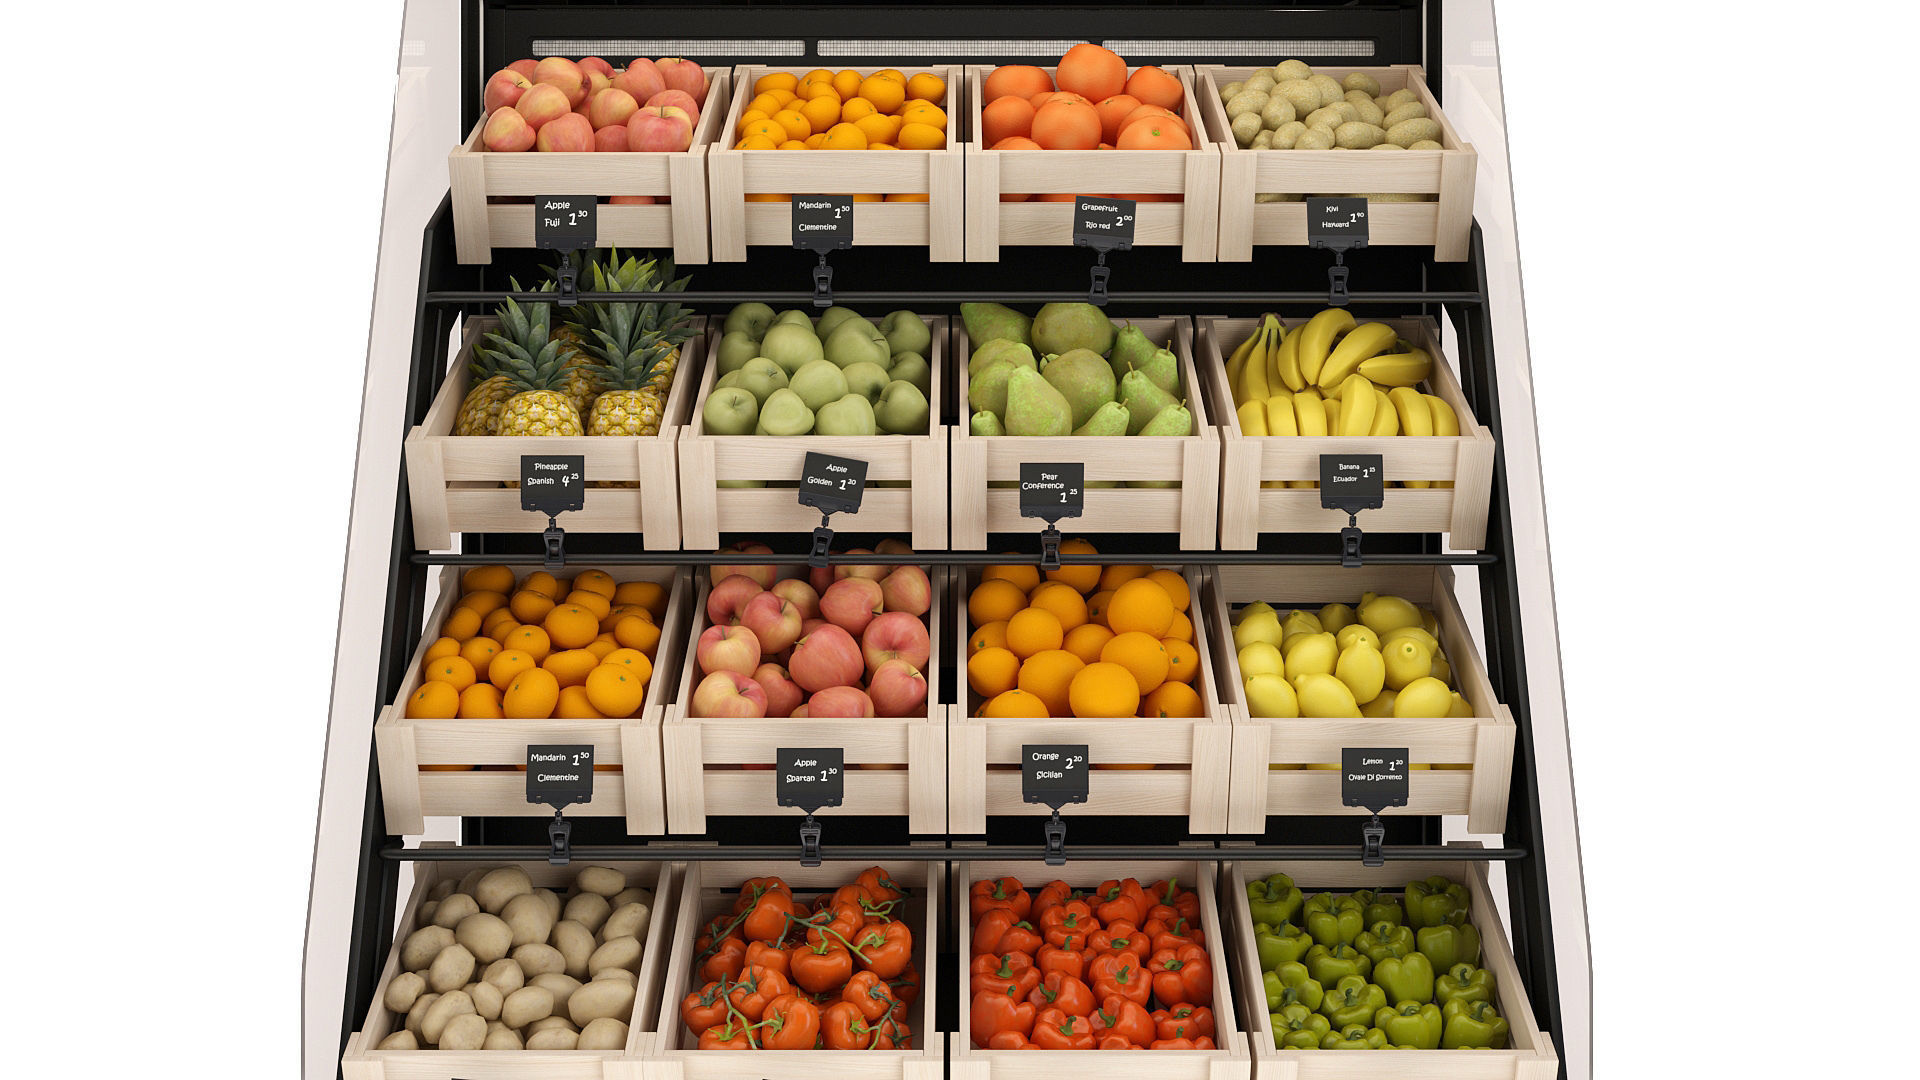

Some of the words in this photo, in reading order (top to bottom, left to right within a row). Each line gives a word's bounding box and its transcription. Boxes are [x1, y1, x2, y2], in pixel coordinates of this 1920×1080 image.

[544, 201, 571, 210] Apple
[1081, 203, 1119, 212] Grapefruit
[544, 218, 560, 227] Fuji
[534, 463, 569, 471] Pineapple
[826, 464, 848, 473] Apple
[527, 477, 555, 486] Spanish
[807, 476, 833, 487] Golden
[1022, 482, 1065, 490] Conference
[530, 754, 567, 762] Mandarin
[1032, 752, 1060, 761] Orange
[794, 759, 818, 767] Apple
[537, 774, 580, 782] Clementine
[786, 774, 816, 784] Spartan
[1036, 771, 1063, 780] Sicilian
